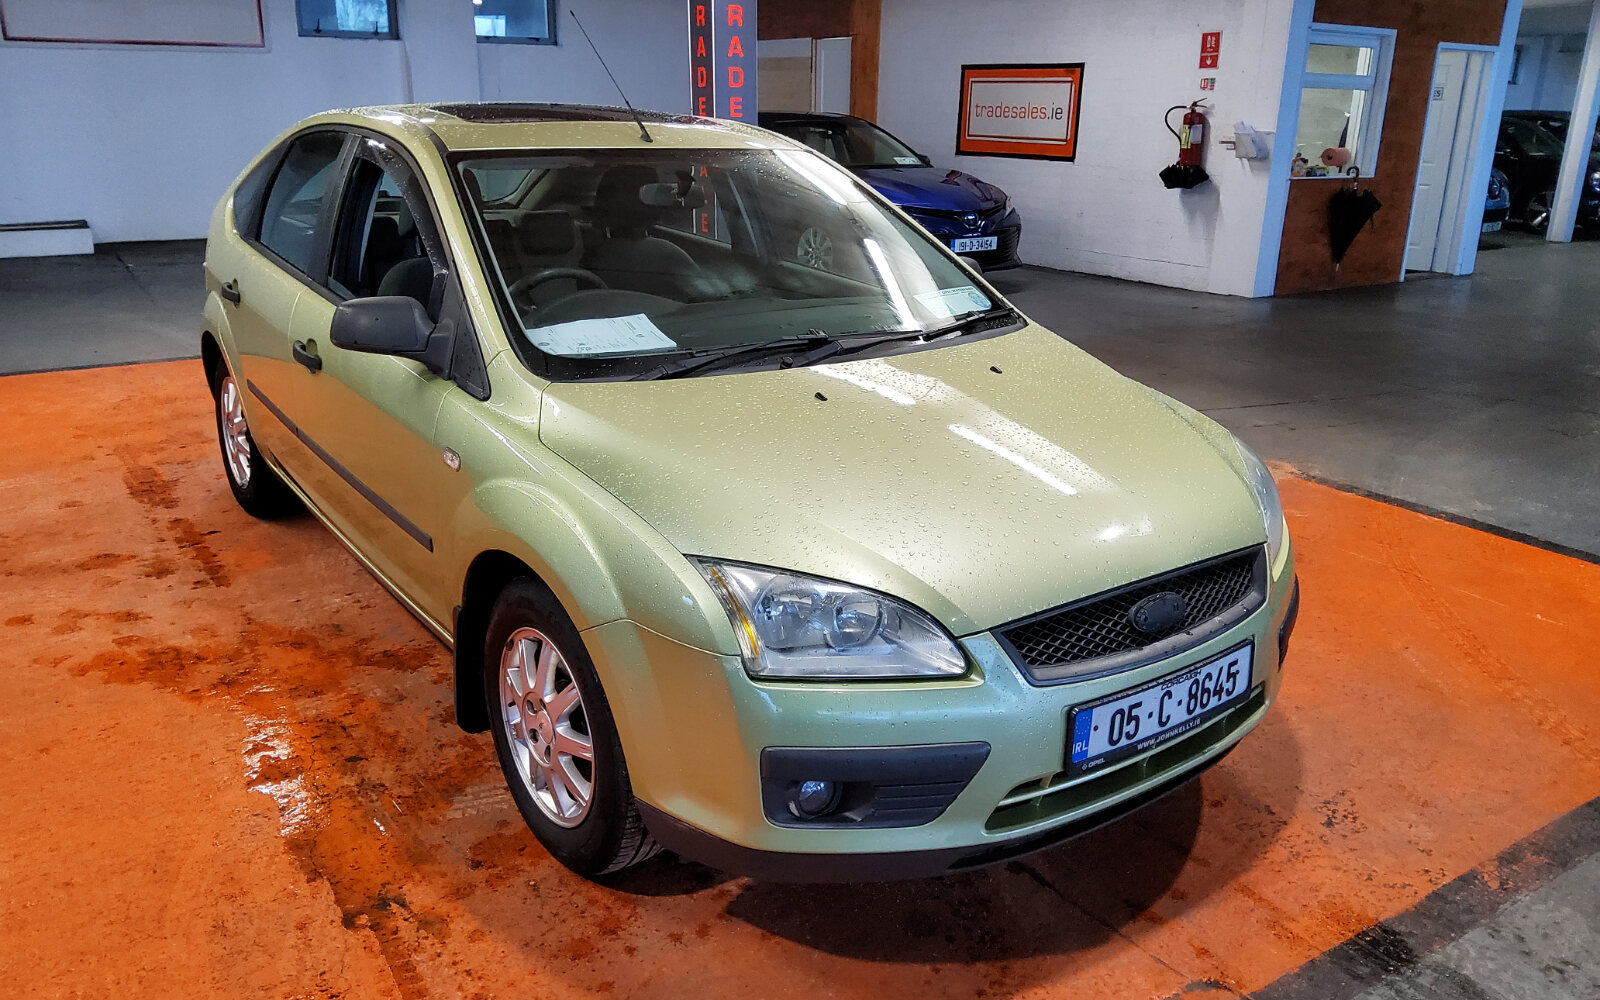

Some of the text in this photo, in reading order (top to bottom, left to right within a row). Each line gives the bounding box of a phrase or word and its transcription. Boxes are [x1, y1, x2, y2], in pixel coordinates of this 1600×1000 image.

[975, 101, 1063, 120] tradesales.ie
[959, 240, 993, 252] 191-D-34154
[1072, 743, 1089, 756] IRL
[1088, 757, 1106, 768] OPEL
